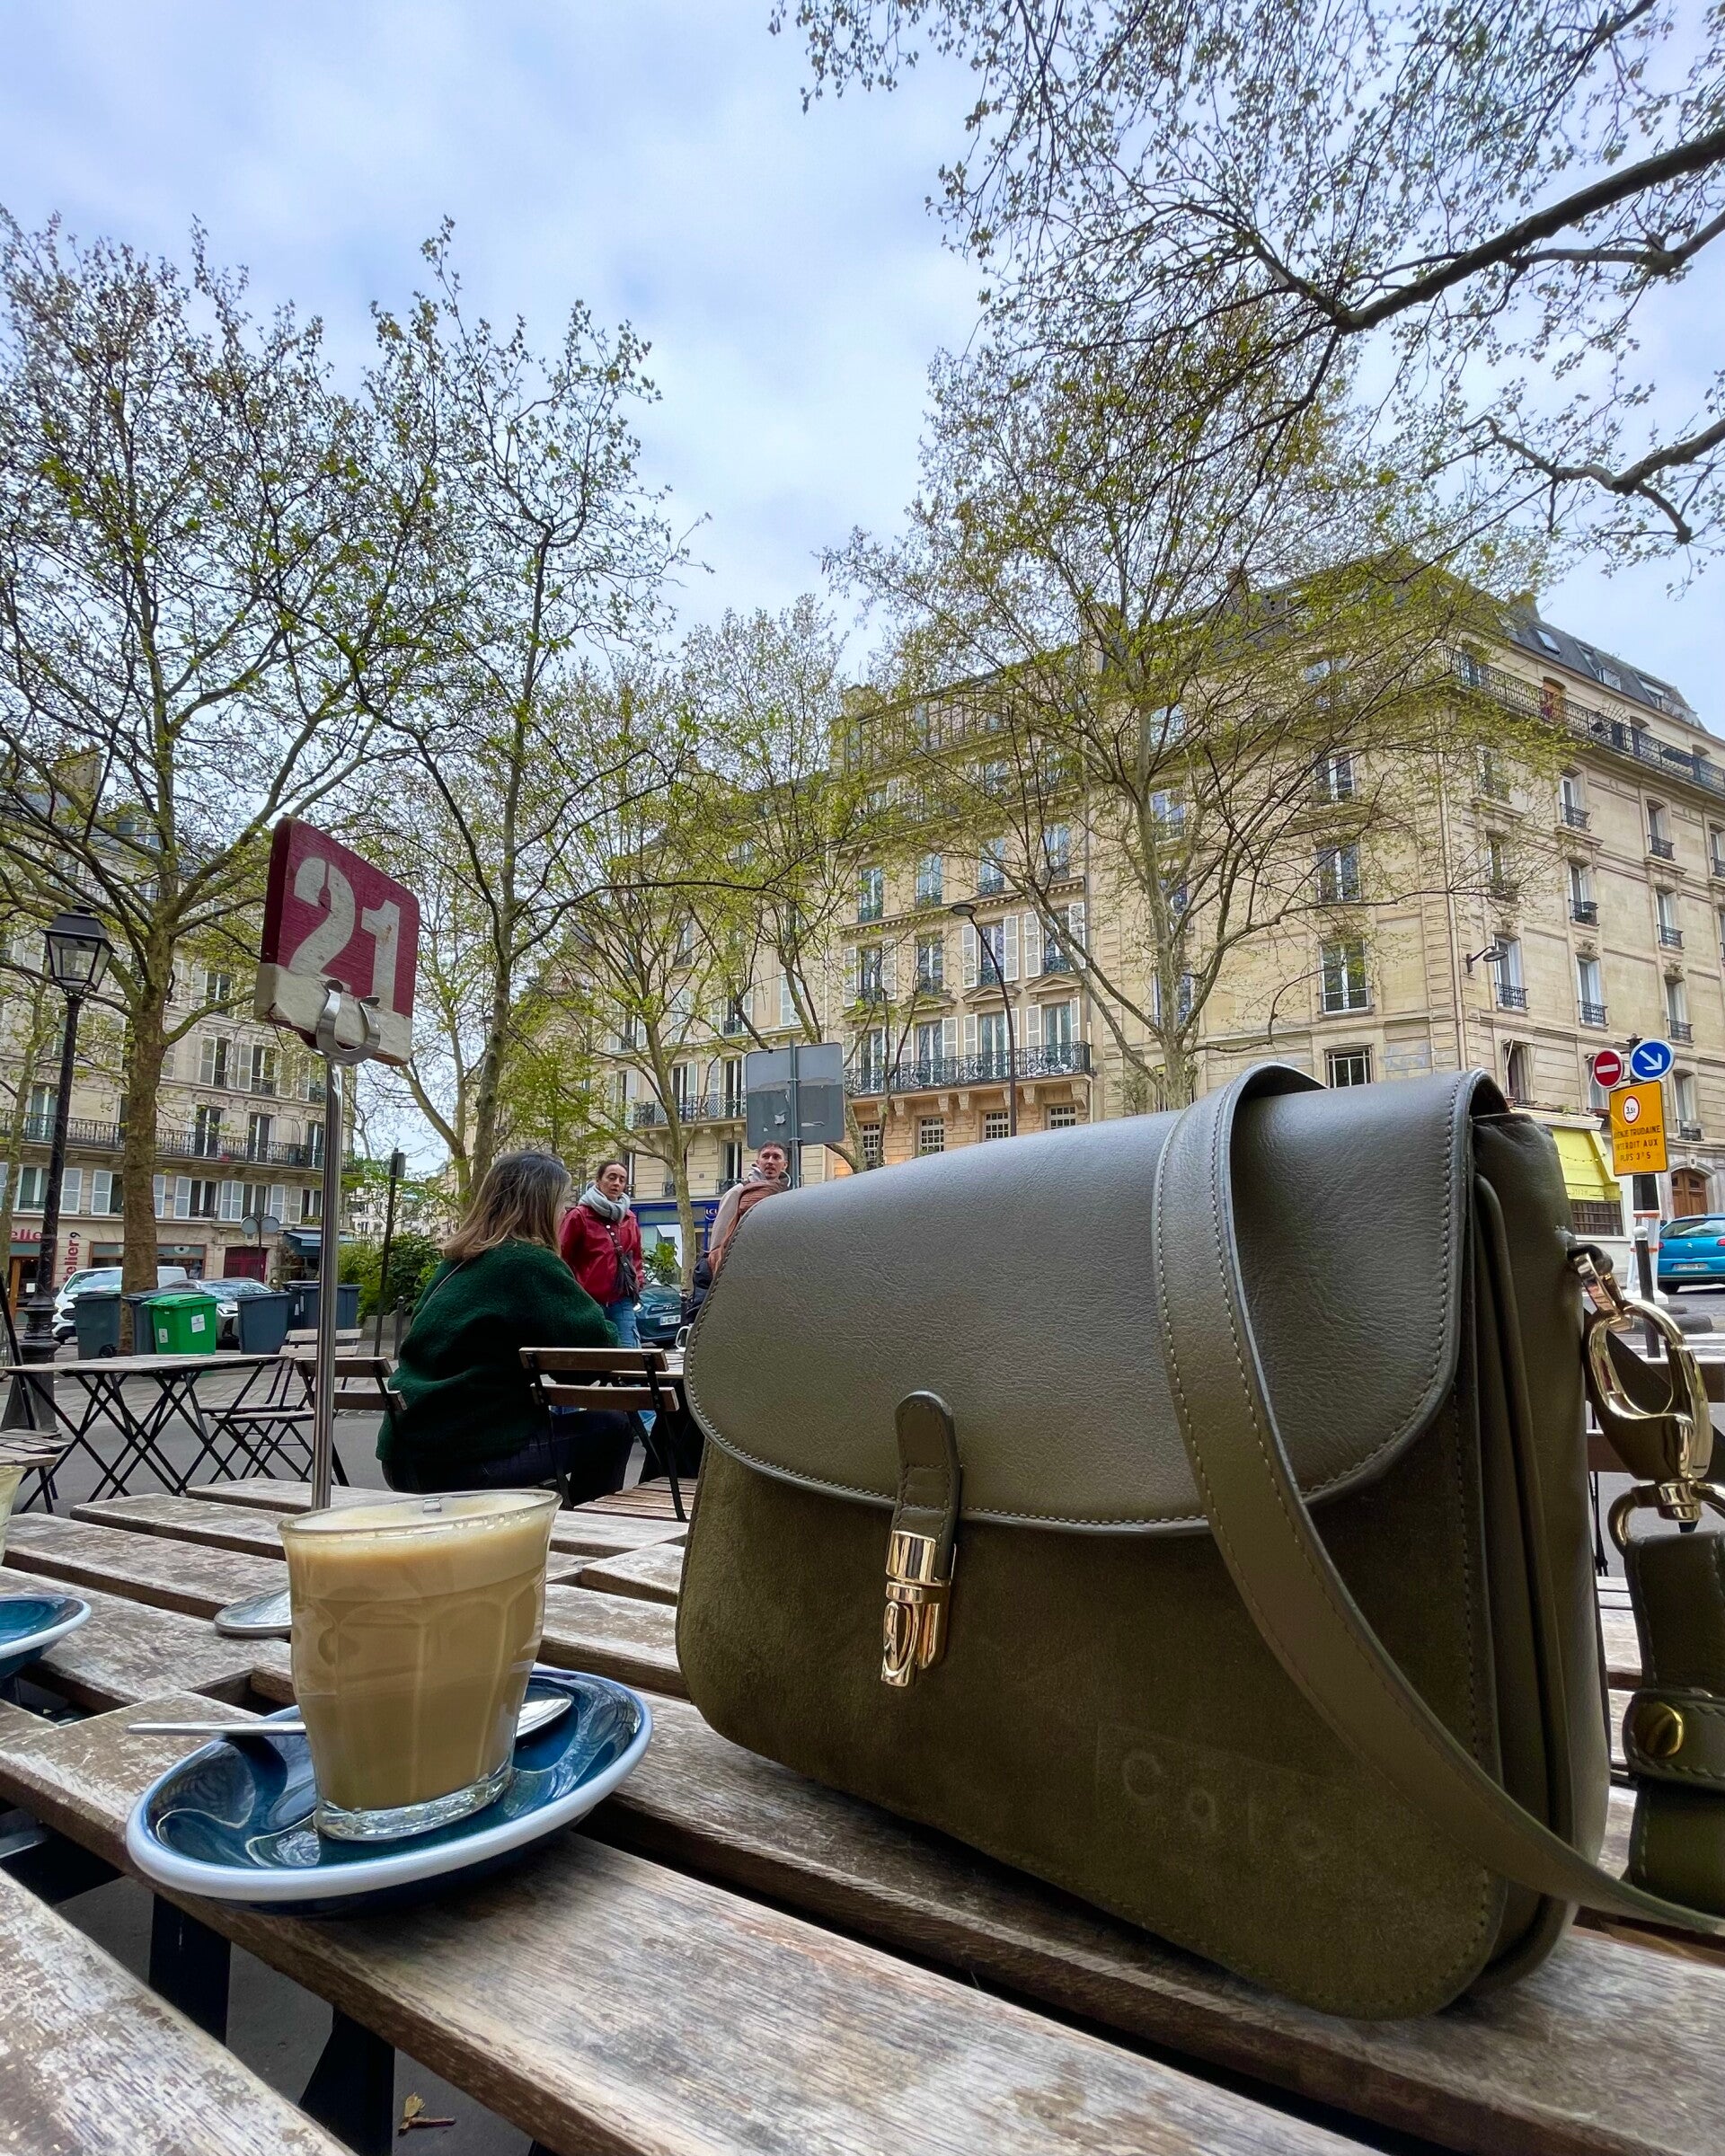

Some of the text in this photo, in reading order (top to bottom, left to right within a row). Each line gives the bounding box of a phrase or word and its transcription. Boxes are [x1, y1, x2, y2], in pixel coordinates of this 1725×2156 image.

[288, 857, 401, 1012] 21
[1615, 1138, 1659, 1151] NTERDIT AUX
[1630, 1125, 1661, 1136] TRUDAINE
[63, 1240, 79, 1283] telier
